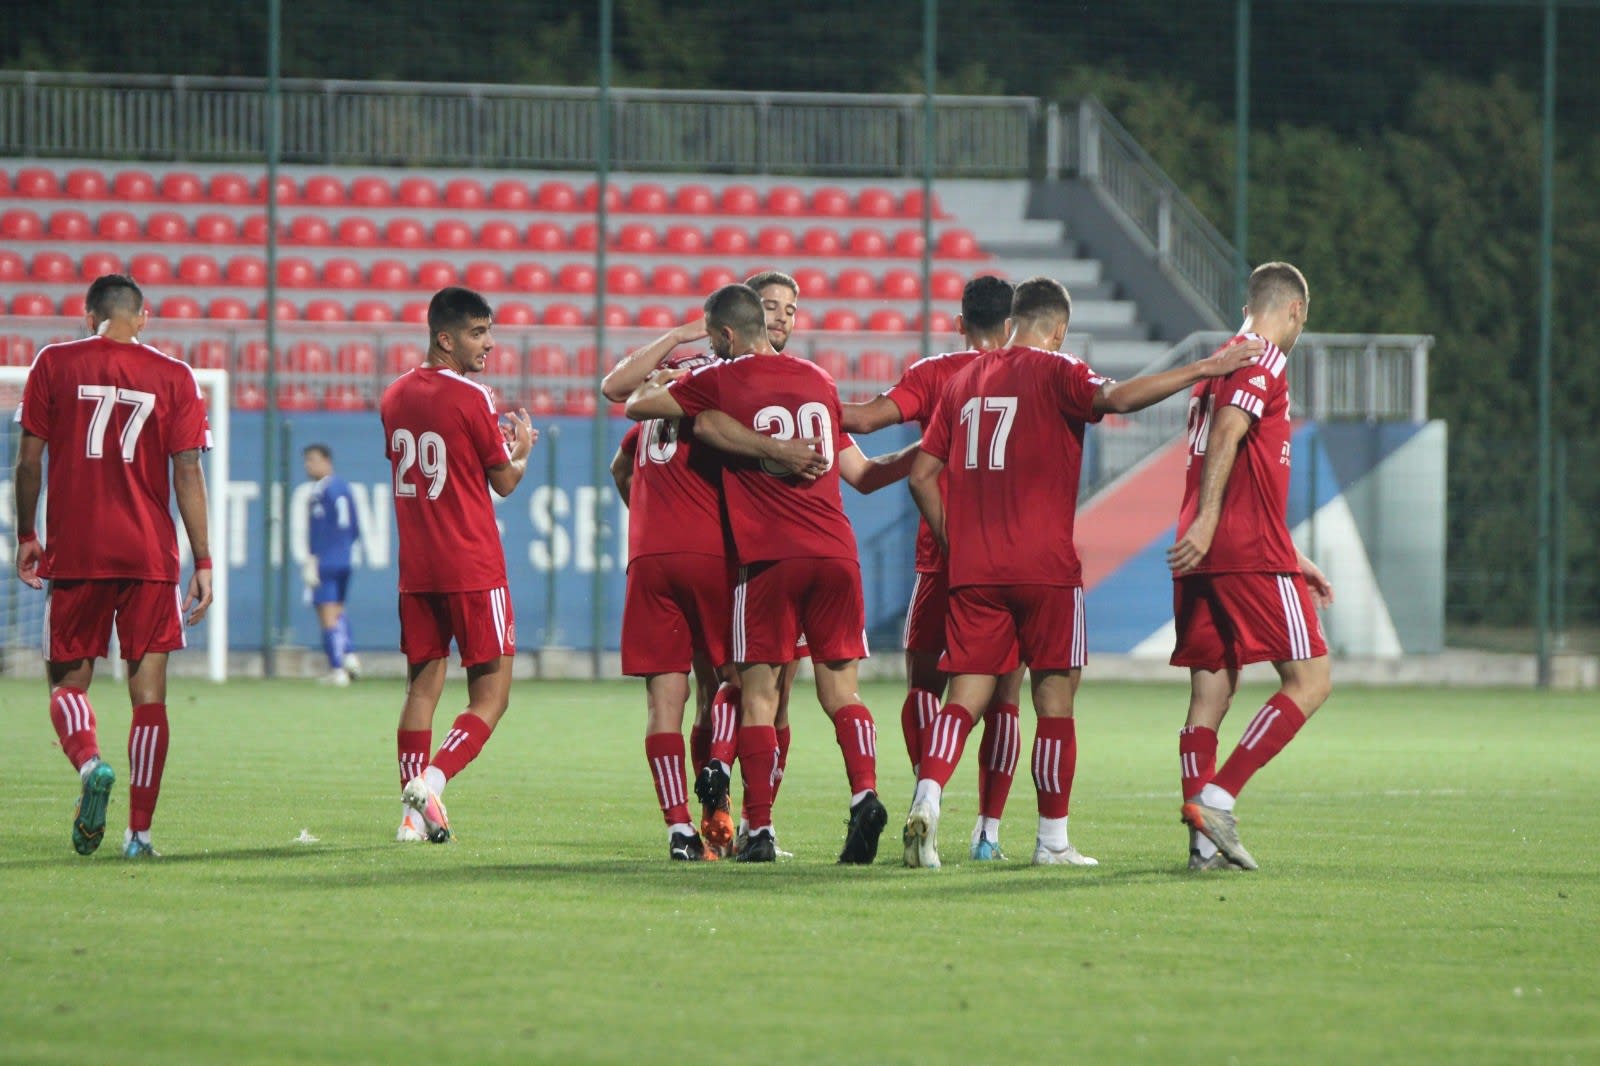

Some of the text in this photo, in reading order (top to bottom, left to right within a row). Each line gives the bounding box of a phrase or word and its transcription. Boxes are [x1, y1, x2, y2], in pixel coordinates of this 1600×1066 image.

[78, 385, 156, 463] 77
[753, 402, 834, 477] 30
[960, 396, 1018, 470] 17
[391, 428, 447, 500] 29
[177, 480, 391, 569] TION
[529, 484, 629, 572] SE
